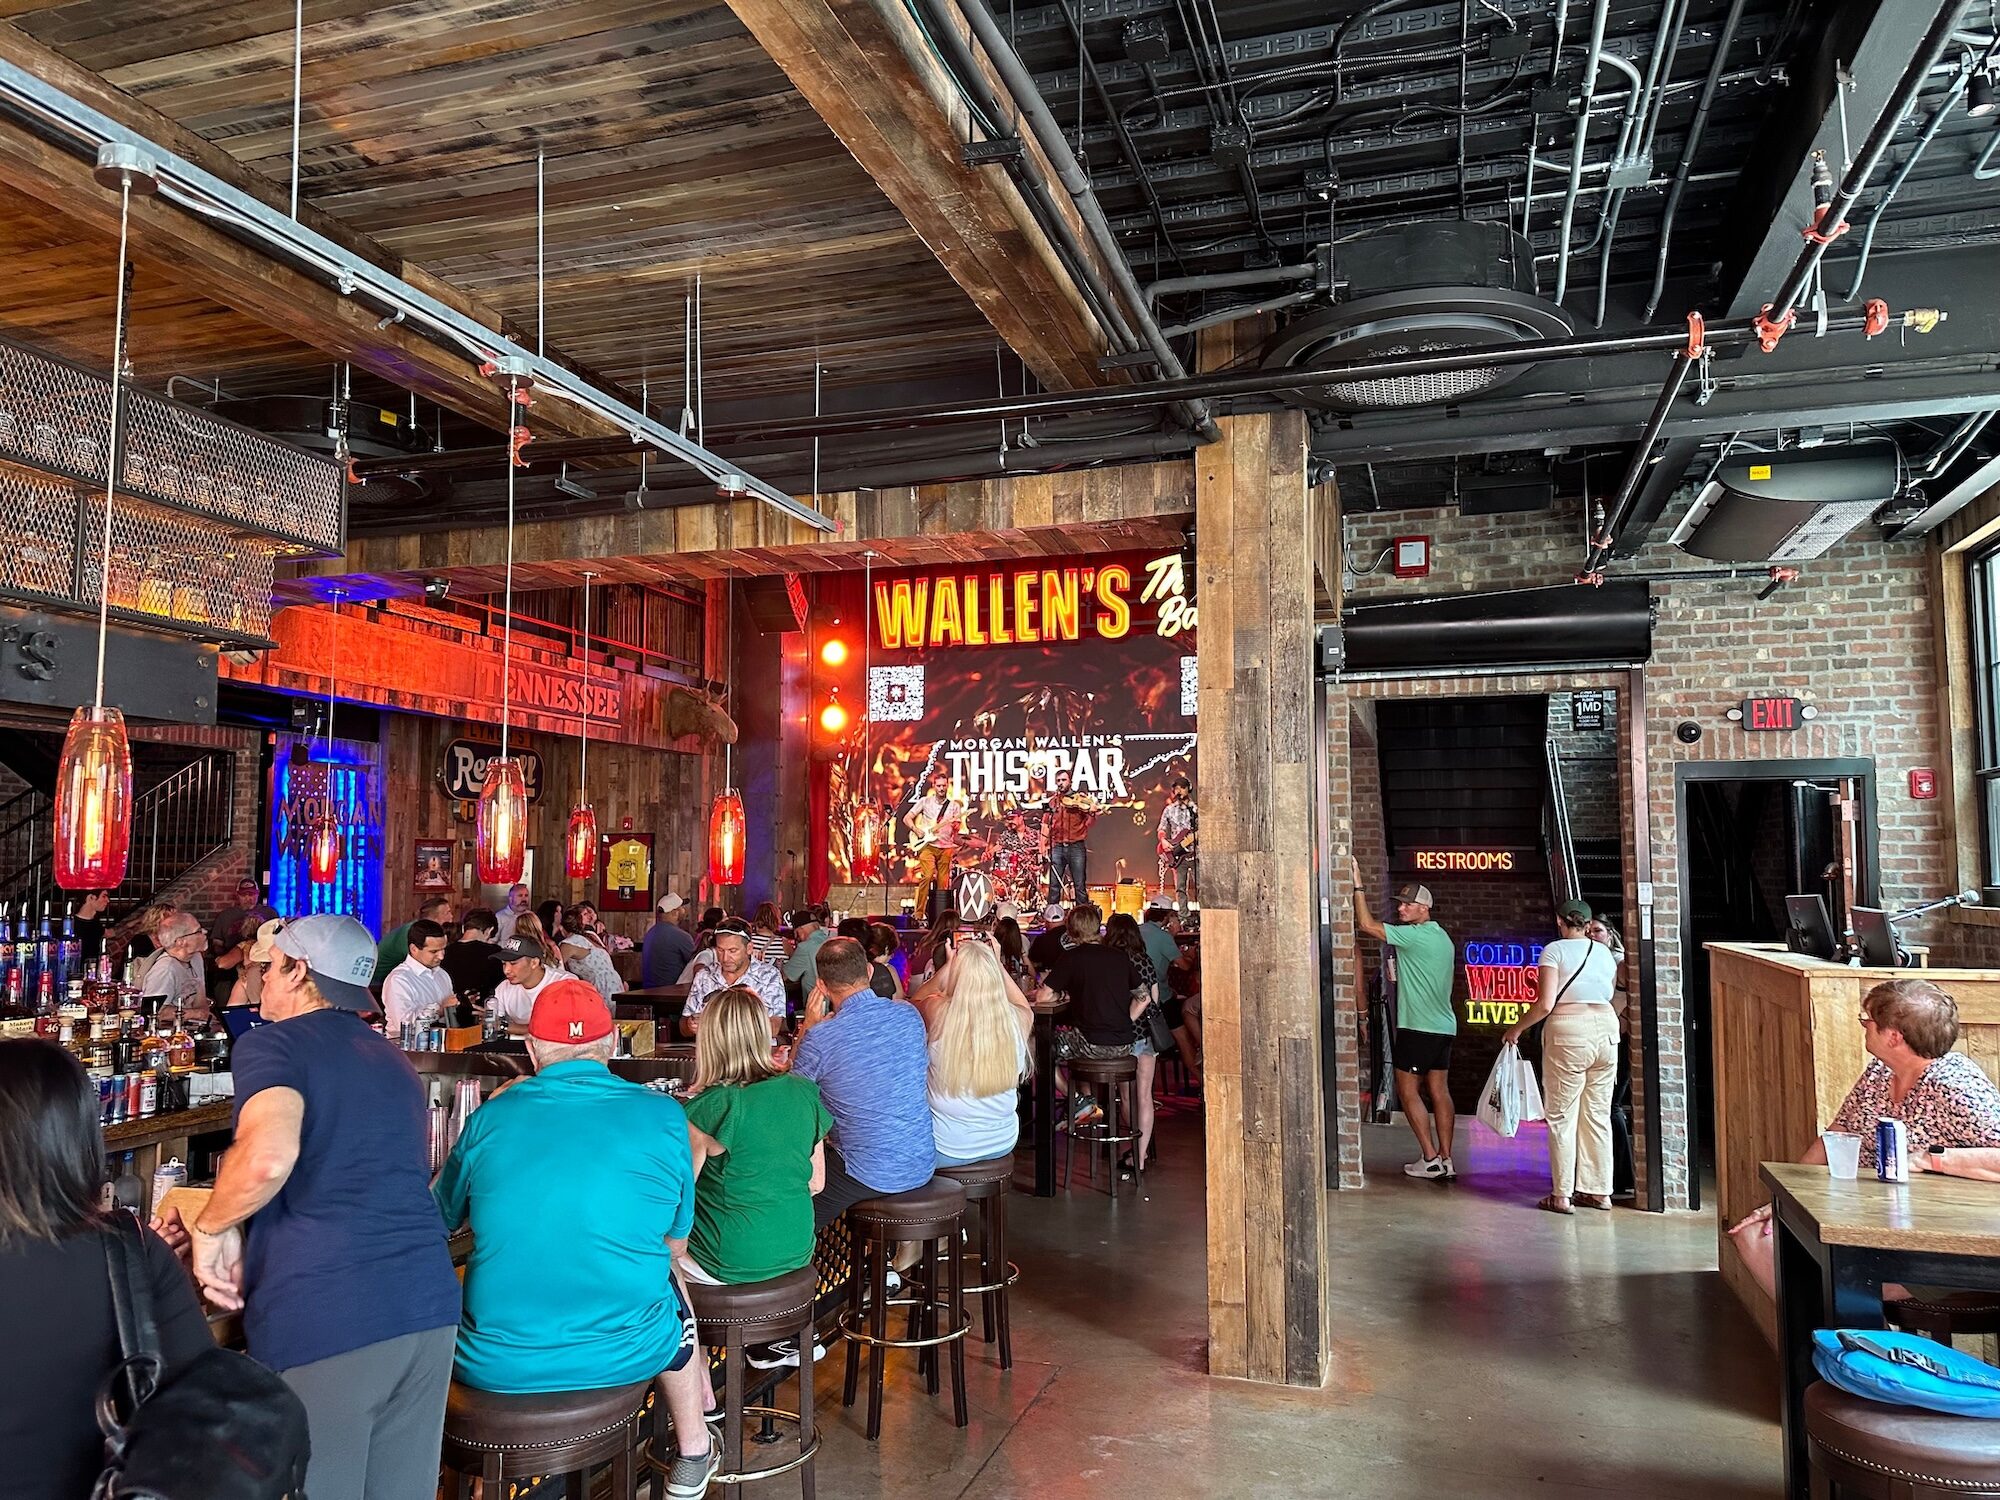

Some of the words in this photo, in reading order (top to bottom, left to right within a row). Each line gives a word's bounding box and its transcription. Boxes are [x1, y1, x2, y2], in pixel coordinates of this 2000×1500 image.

[874, 564, 1130, 649] WALLEN'S
[1157, 595, 1198, 637] Ba
[481, 661, 621, 719] TENNESSEE
[1752, 699, 1794, 729] EXIT
[950, 737, 1027, 751] MORGAN
[1035, 734, 1122, 749] WALLEN'S
[945, 750, 1030, 800] THIS
[1416, 852, 1513, 870] RESTROOMS
[1466, 943, 1524, 965] COLD
[1465, 965, 1539, 1003] WHIS
[1466, 1001, 1519, 1025] LIVE
[45, 1022, 59, 1033] 46
[568, 1021, 584, 1037] M
